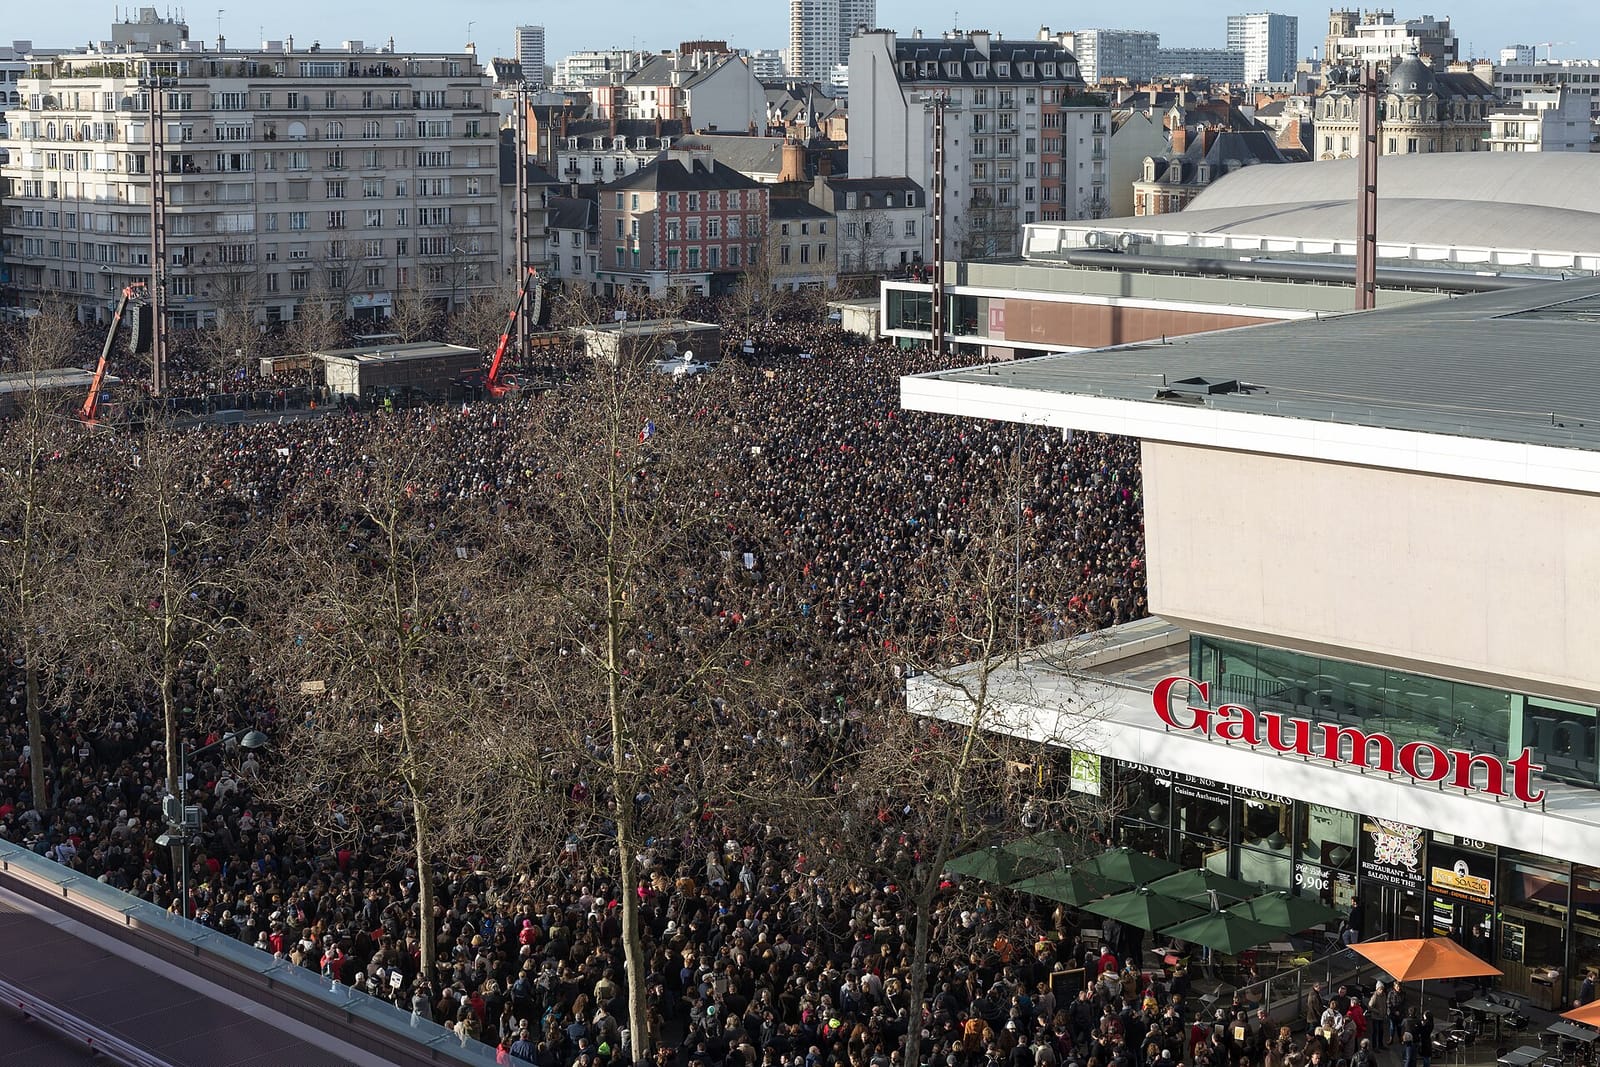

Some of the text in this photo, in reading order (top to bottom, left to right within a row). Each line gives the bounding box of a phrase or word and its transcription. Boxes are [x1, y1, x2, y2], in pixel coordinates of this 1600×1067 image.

[1152, 676, 1546, 803] Gaumont
[1185, 775, 1197, 784] DE
[1174, 786, 1230, 806] Cuisine Authentique
[1362, 861, 1405, 878] RESTAURANT
[1408, 872, 1423, 882] BAR
[1367, 870, 1390, 881] SALON
[1390, 876, 1401, 885] DE
[1294, 873, 1330, 890] 9,90€
